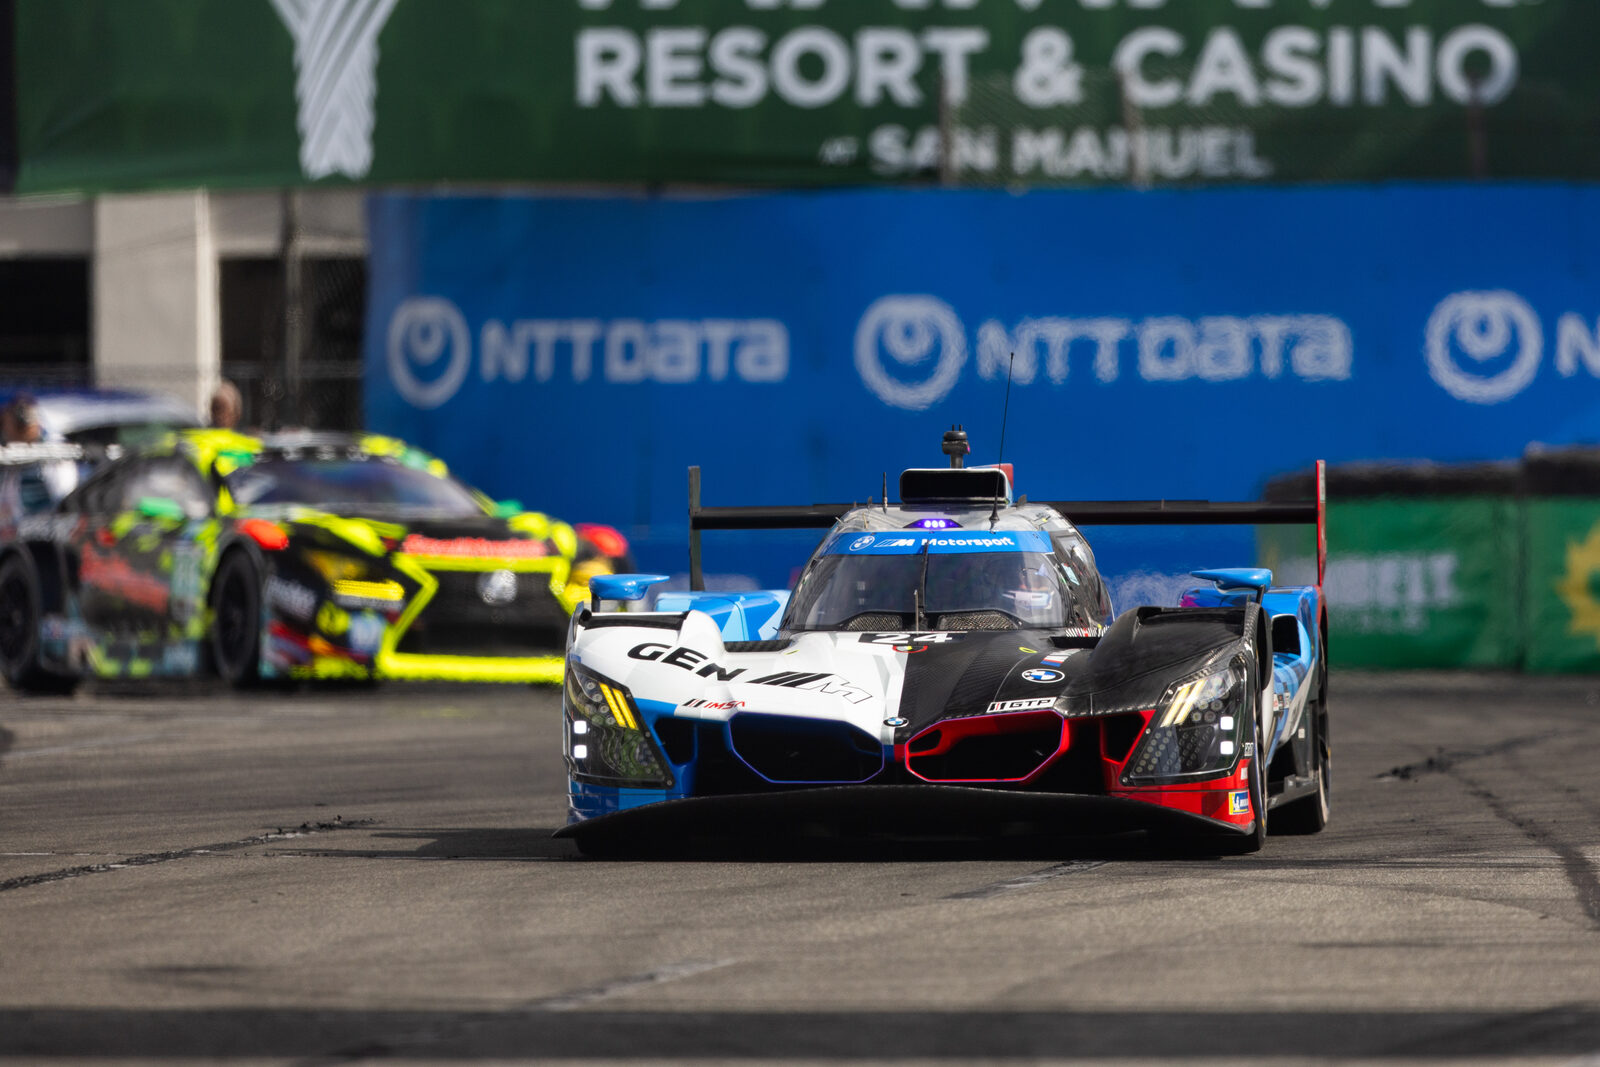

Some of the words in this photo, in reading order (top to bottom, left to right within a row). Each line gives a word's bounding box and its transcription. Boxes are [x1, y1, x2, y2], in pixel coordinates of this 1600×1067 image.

[576, 26, 988, 106] RESORT
[1013, 26, 1083, 107] &
[1112, 25, 1516, 107] CASINO
[870, 124, 999, 173] SAN
[1011, 125, 1267, 178] MANUEL
[921, 537, 1015, 548] Motorsport
[871, 632, 953, 644] 24
[627, 642, 748, 682] GEN
[703, 700, 746, 711] IMSA
[1009, 699, 1052, 709] GTP
